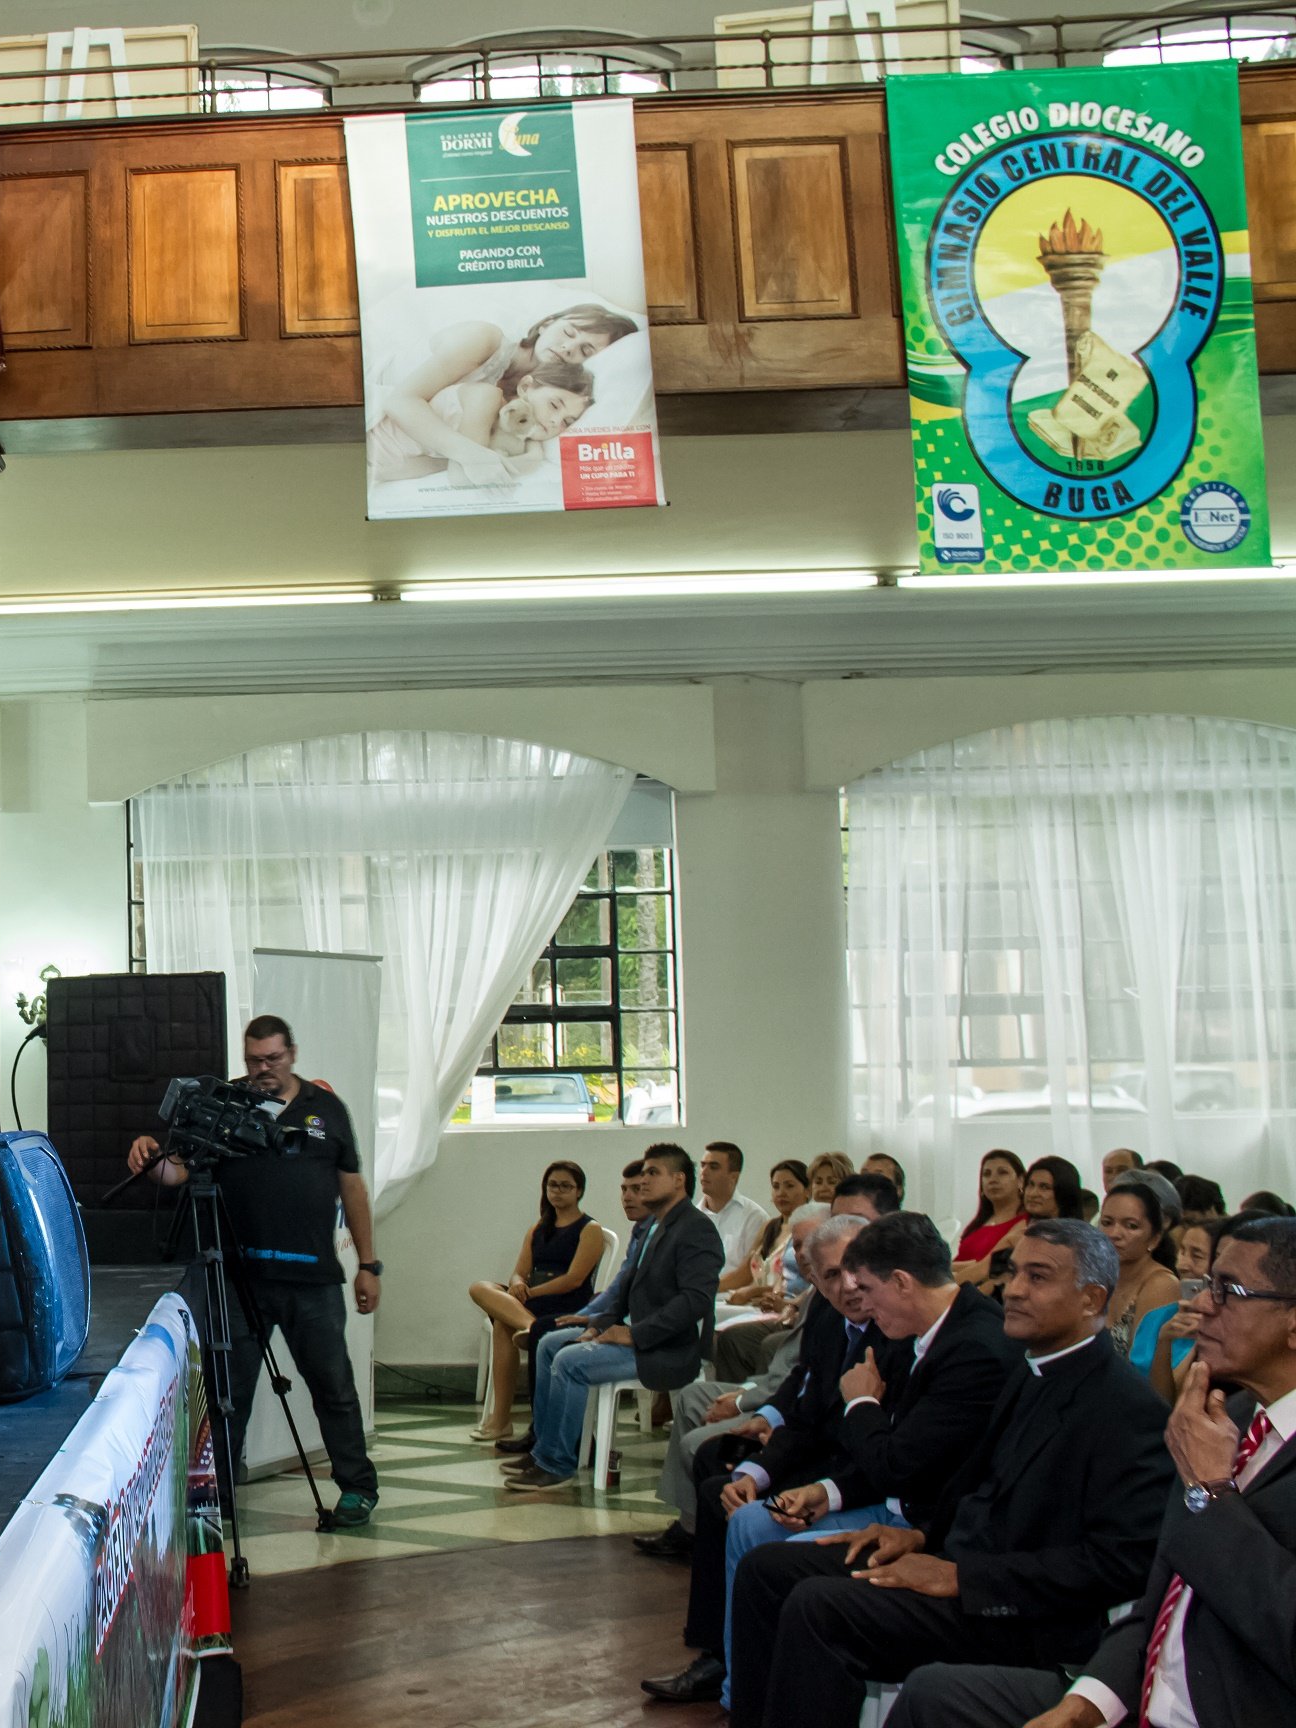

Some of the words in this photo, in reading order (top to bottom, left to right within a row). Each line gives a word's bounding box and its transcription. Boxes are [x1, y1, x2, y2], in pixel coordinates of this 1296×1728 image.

[441, 137, 493, 152] DORMI
[934, 106, 1040, 176] COLEGIO
[1048, 101, 1205, 168] DIOCESANO
[433, 187, 561, 212] APROVECHA
[425, 211, 489, 226] NUESTROS
[490, 206, 570, 222] DESCUENTOS
[427, 229, 435, 239] Y
[435, 226, 478, 239] DISFRUTA
[479, 226, 489, 235] EL
[490, 224, 522, 235] MEJOR
[522, 220, 570, 233] DESCANSO
[936, 172, 1002, 328] GIMNASIO
[1000, 141, 1142, 183] CENTRAL
[1142, 168, 1197, 223] DEL
[1179, 226, 1214, 321] VALLE
[459, 246, 515, 260] PAGANDO
[516, 245, 541, 257] CON
[457, 259, 505, 273] CRÉDITO
[506, 257, 545, 270] BRILLA
[577, 441, 635, 462] Brilla
[1066, 460, 1105, 472] 1958
[1042, 479, 1135, 513] BUGA
